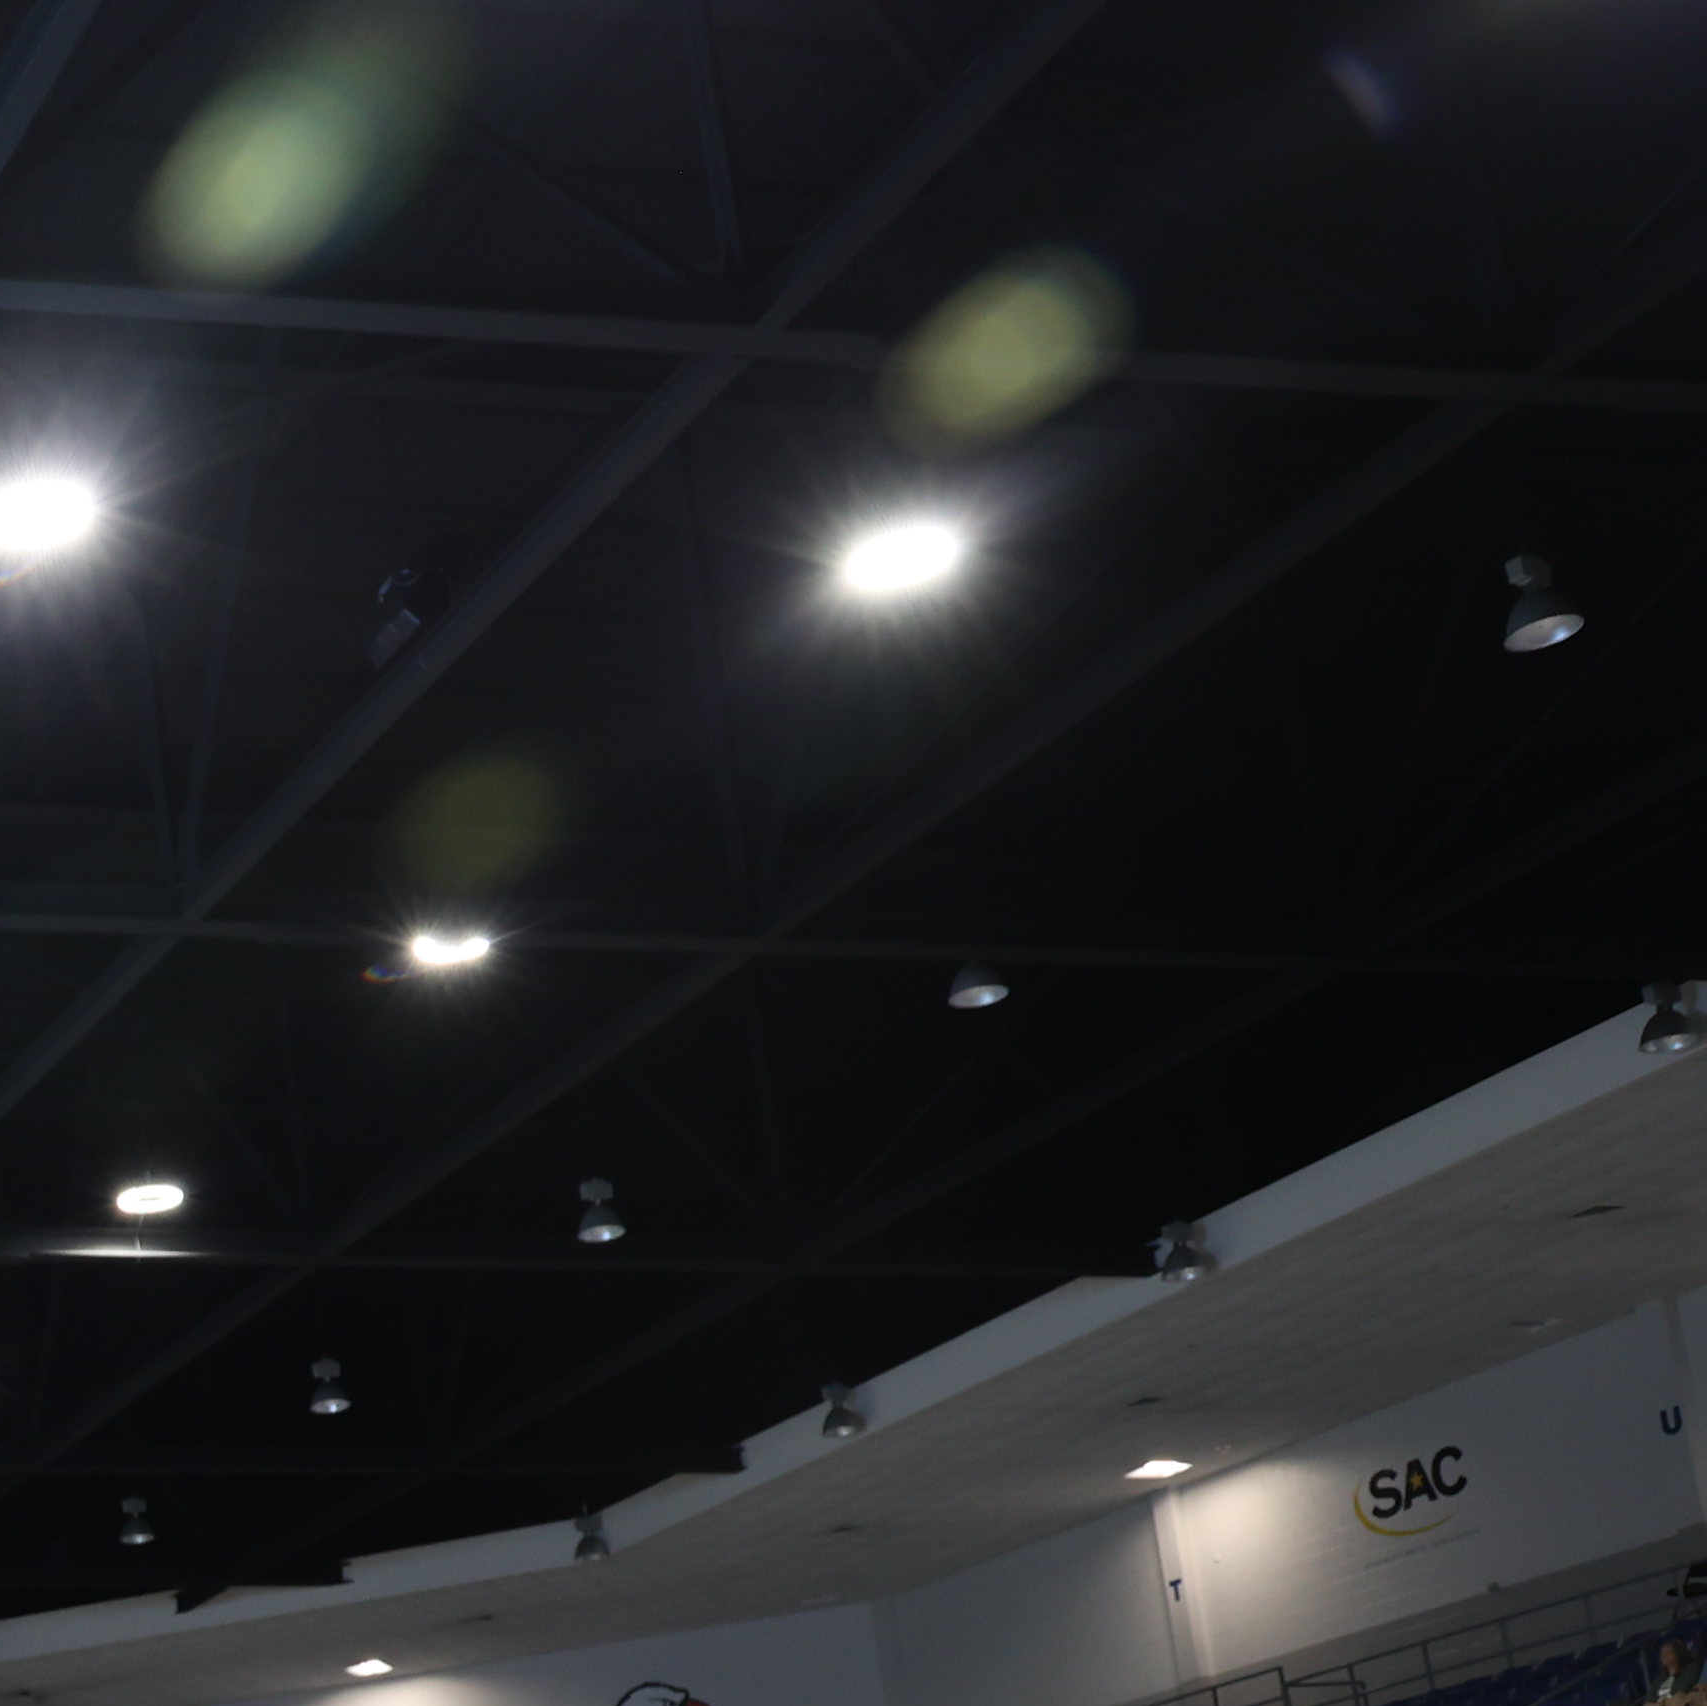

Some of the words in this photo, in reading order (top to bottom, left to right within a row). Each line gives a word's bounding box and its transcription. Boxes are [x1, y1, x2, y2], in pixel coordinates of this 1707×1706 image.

[1660, 1405, 1682, 1435] U
[1369, 1445, 1468, 1519] SAC
[1169, 1578, 1182, 1601] T
